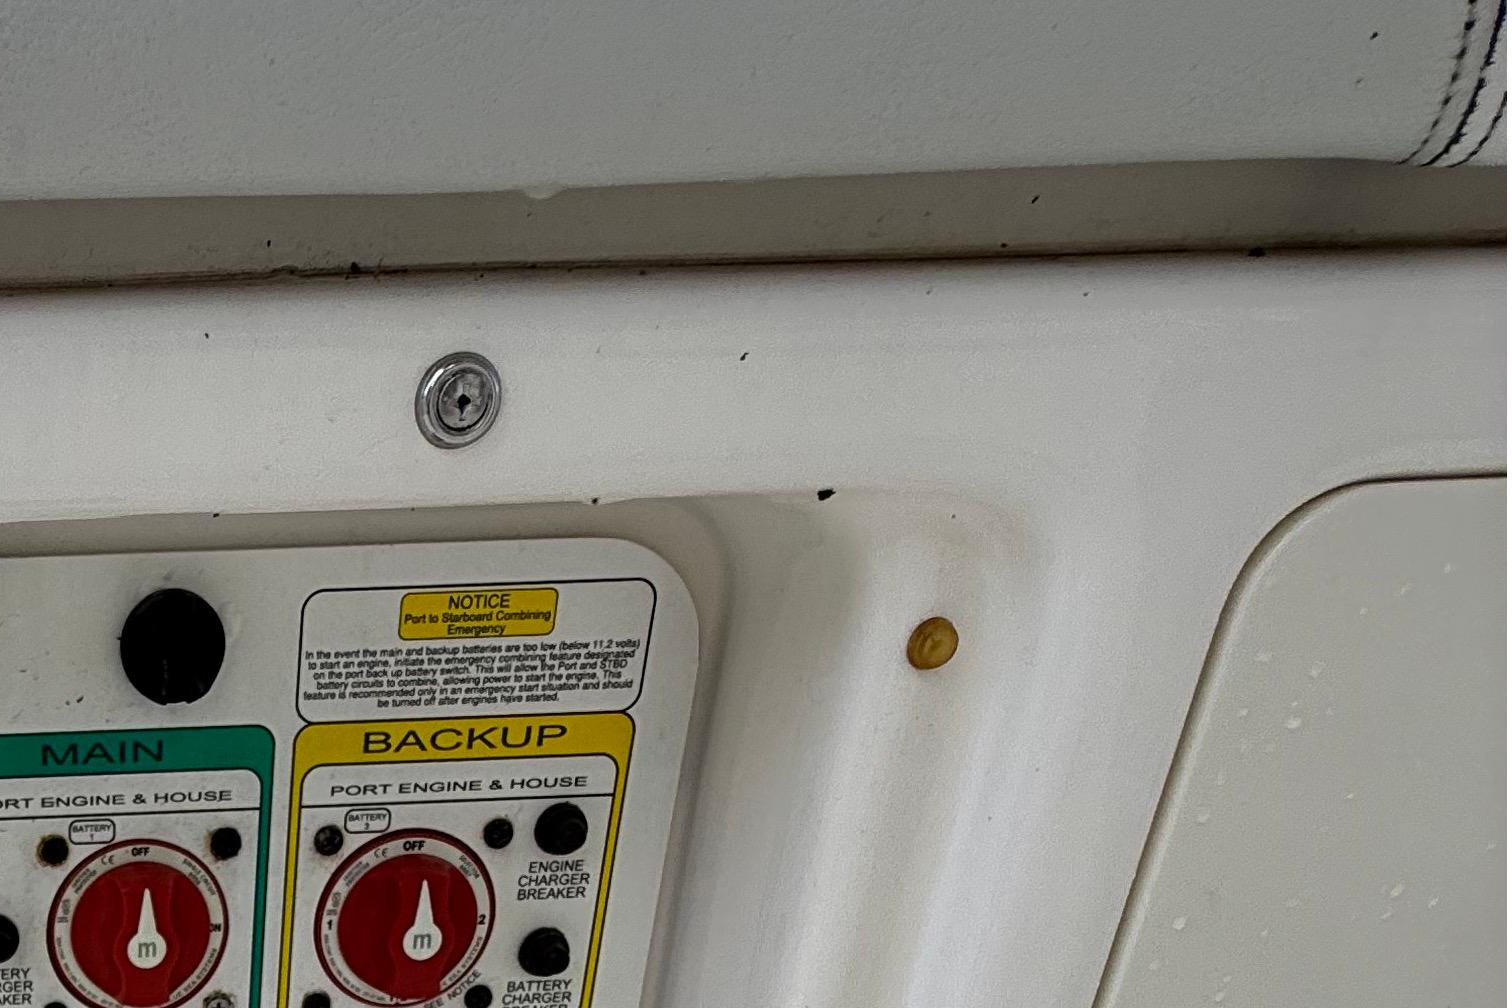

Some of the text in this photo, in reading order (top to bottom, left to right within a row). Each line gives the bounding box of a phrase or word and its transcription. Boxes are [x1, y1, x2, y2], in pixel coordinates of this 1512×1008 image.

[448, 594, 510, 609] NOTICE
[404, 609, 551, 624] Port to Starboard Combining
[448, 624, 506, 636] Emergency
[405, 647, 423, 656] and
[425, 646, 459, 657] backup
[362, 724, 568, 754] BACKUP
[41, 740, 164, 767] MAIN
[330, 776, 588, 797] PORT ENGINE & HOUSE
[41, 794, 126, 808] ENGINE
[132, 794, 146, 805] &
[154, 790, 232, 803] HOUSE
[348, 813, 387, 822] BATTERY
[72, 824, 111, 833] BATTERY
[131, 847, 150, 857] OFF
[403, 841, 426, 851] OFF
[529, 859, 584, 873] ENGINE
[518, 873, 590, 887] CHARGER
[517, 886, 586, 901] BREAKER
[327, 920, 333, 930] 1
[478, 914, 486, 925] 2
[413, 933, 432, 949] m
[138, 941, 157, 958] m
[447, 968, 481, 1000] NOTICE
[507, 979, 573, 993] BATTERY
[502, 991, 572, 1005] CHARGER
